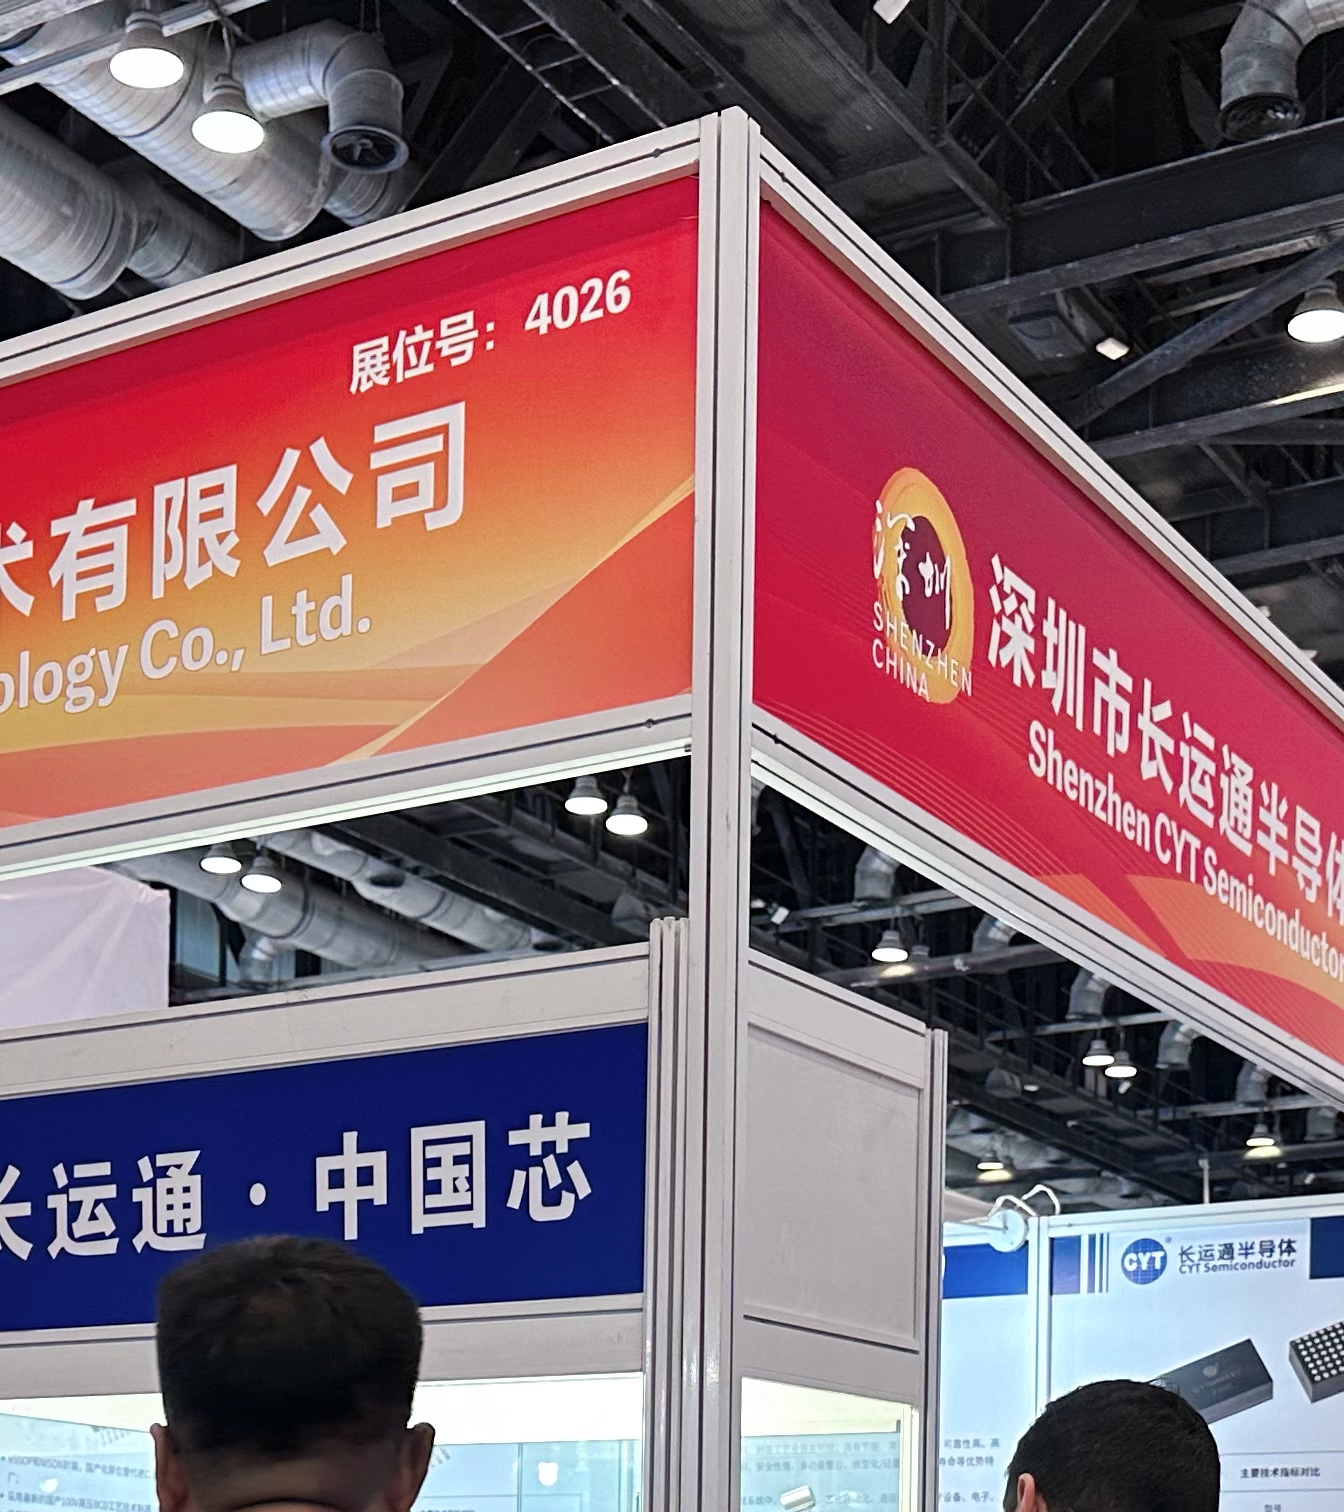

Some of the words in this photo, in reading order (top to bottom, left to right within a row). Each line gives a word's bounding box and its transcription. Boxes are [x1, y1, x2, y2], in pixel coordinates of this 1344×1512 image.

[139, 619, 244, 680] Co.,
[261, 574, 372, 656] Ltd.
[873, 601, 973, 697] SHENZHEN
[872, 637, 930, 703] CHINA
[1029, 719, 1152, 854] Shenzhen
[1155, 816, 1202, 883] CYT
[1122, 1250, 1164, 1272] CYT
[1178, 1238, 1298, 1265] 长运通半导体
[1178, 1261, 1201, 1275] CYT
[1202, 1257, 1297, 1274] Semiconductor
